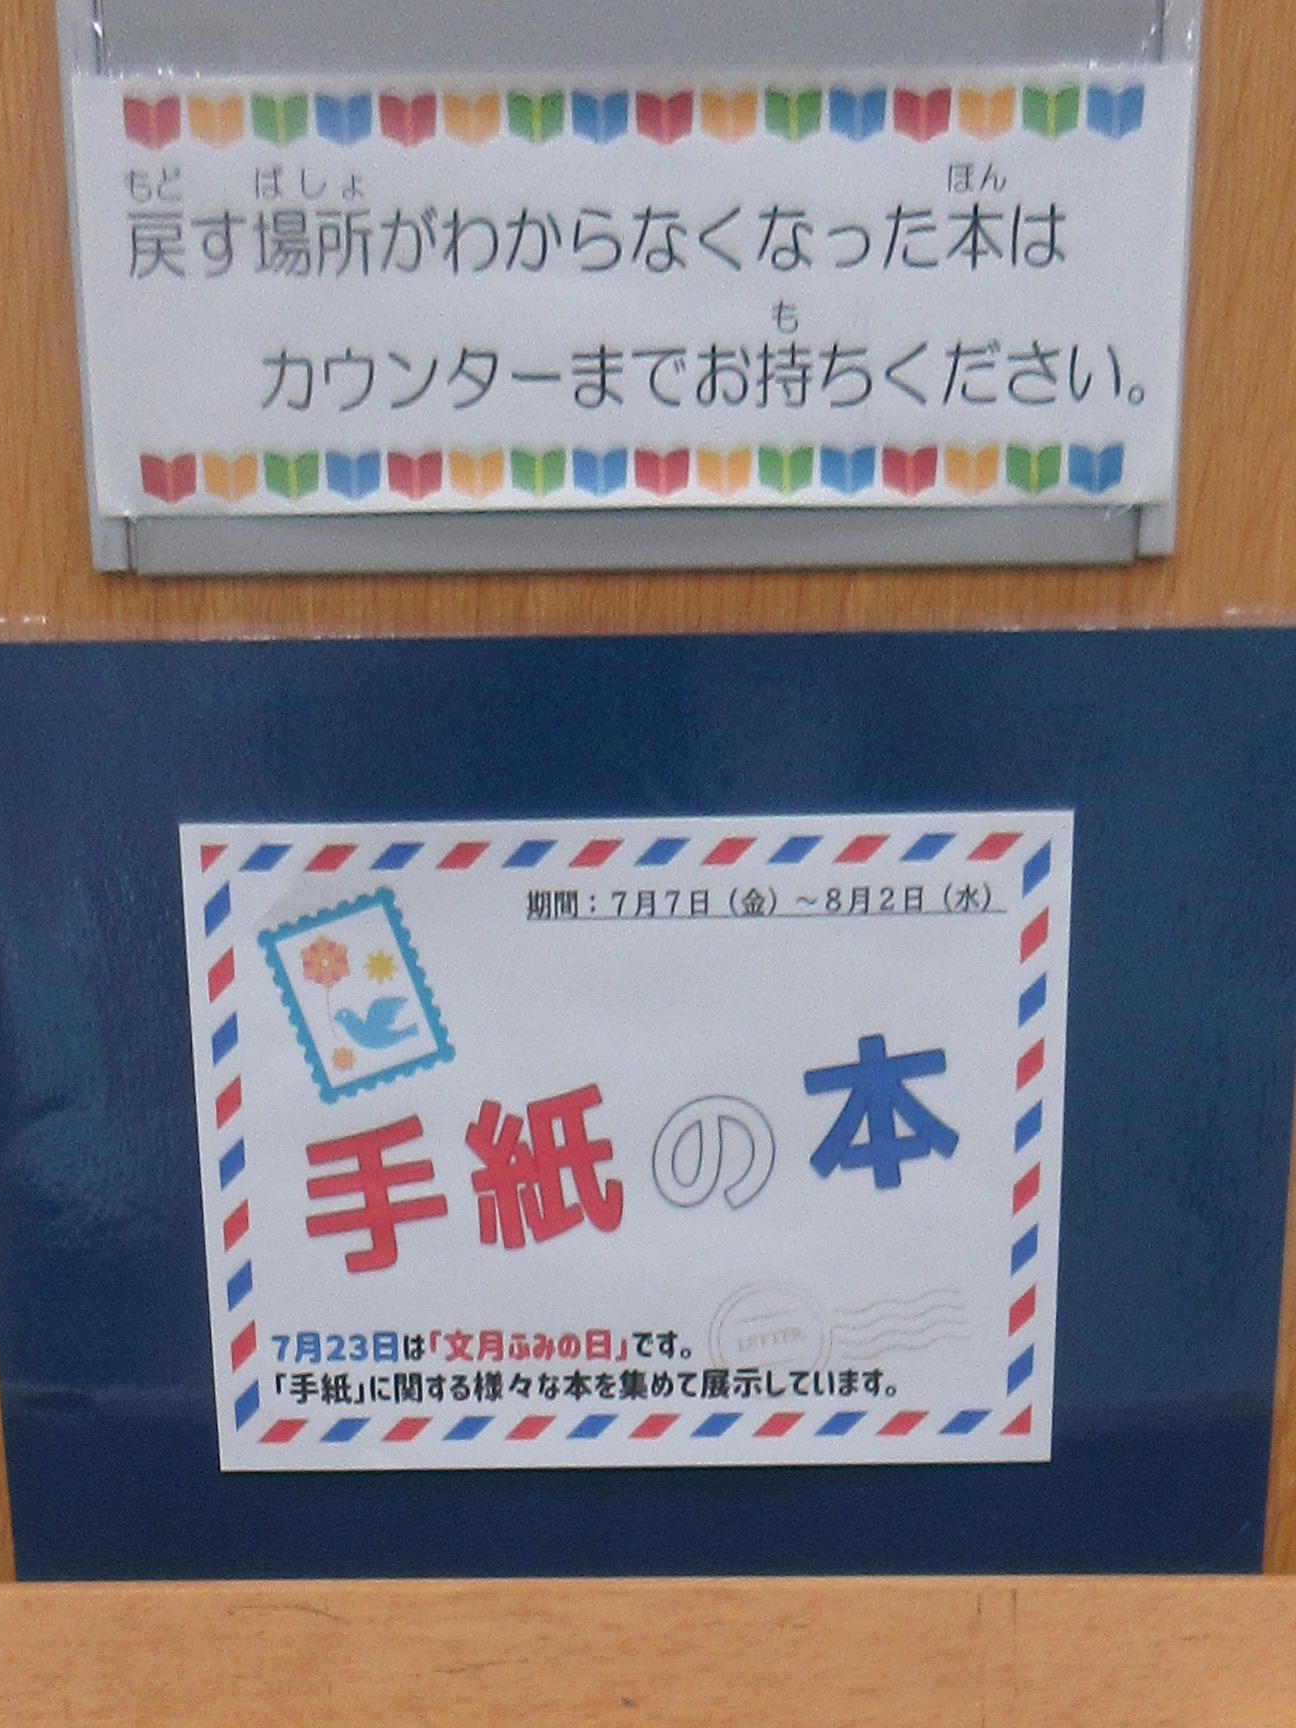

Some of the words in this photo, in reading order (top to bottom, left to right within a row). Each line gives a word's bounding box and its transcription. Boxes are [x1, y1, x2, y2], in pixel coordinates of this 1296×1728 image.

[126, 166, 182, 201] もど
[254, 166, 366, 199] ばしょ
[946, 162, 1008, 194] ほん
[126, 203, 1067, 280] 戻す場所がわからなくなった本は
[769, 300, 801, 334] も
[259, 342, 1149, 410] カウンターまでお持ちください。
[304, 1033, 961, 1274] 手紙の本
[270, 1330, 694, 1364] 7月23日は「文月ふみの日」です。
[271, 1367, 899, 1406] 「手紙」に関する様々な本を集めて展示しています。
